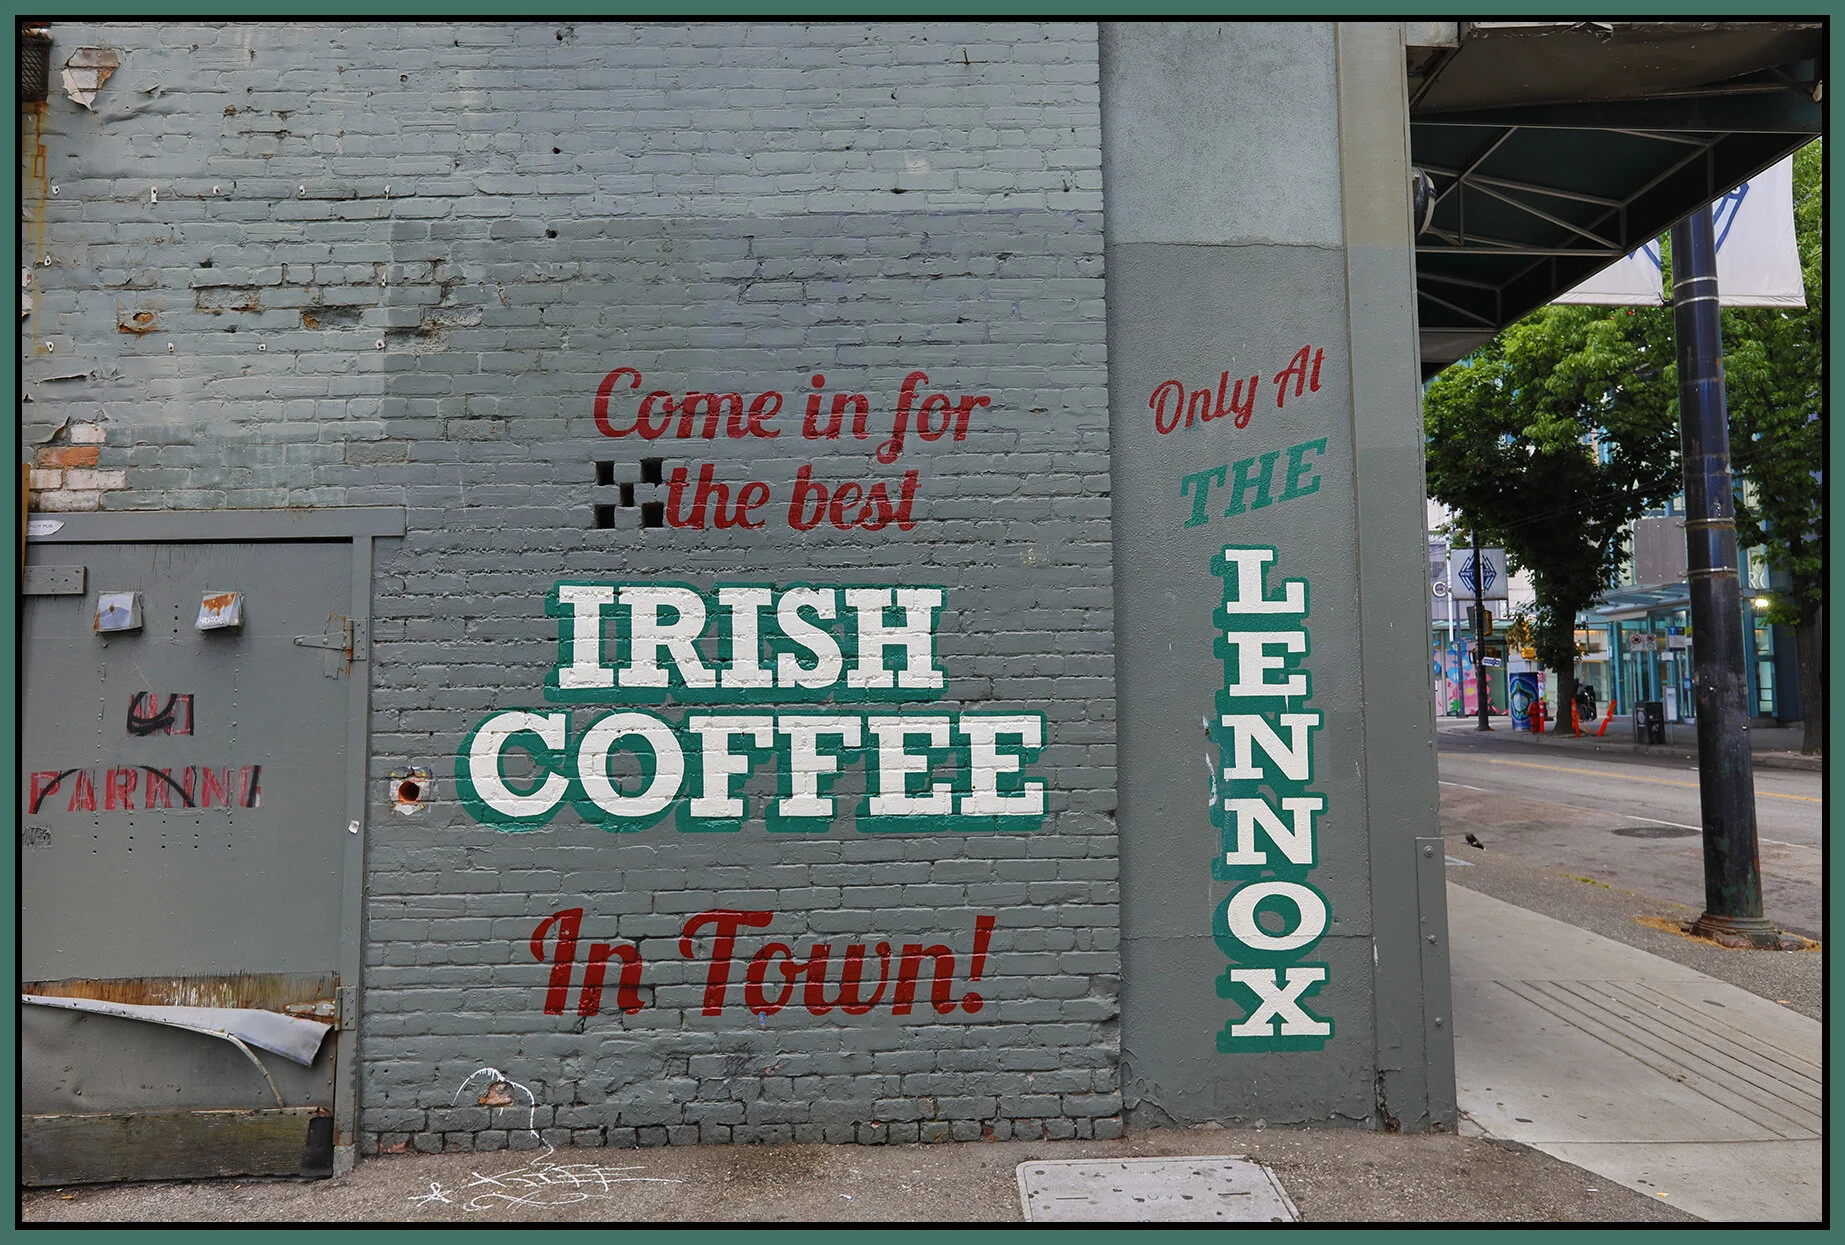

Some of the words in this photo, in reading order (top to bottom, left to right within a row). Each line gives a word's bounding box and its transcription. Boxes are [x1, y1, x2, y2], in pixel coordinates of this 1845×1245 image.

[593, 366, 784, 440] Come
[802, 373, 871, 441] in
[875, 371, 991, 464] for
[1148, 370, 1259, 435] Only
[1272, 344, 1326, 408] At
[665, 463, 771, 530] the
[787, 464, 922, 532] best
[1179, 437, 1328, 529] THE
[556, 583, 945, 691] IRISH
[467, 710, 1046, 818] COFFEE
[1221, 547, 1332, 1038] LENNOX
[530, 907, 646, 1016] In
[678, 908, 996, 1017] Town!
